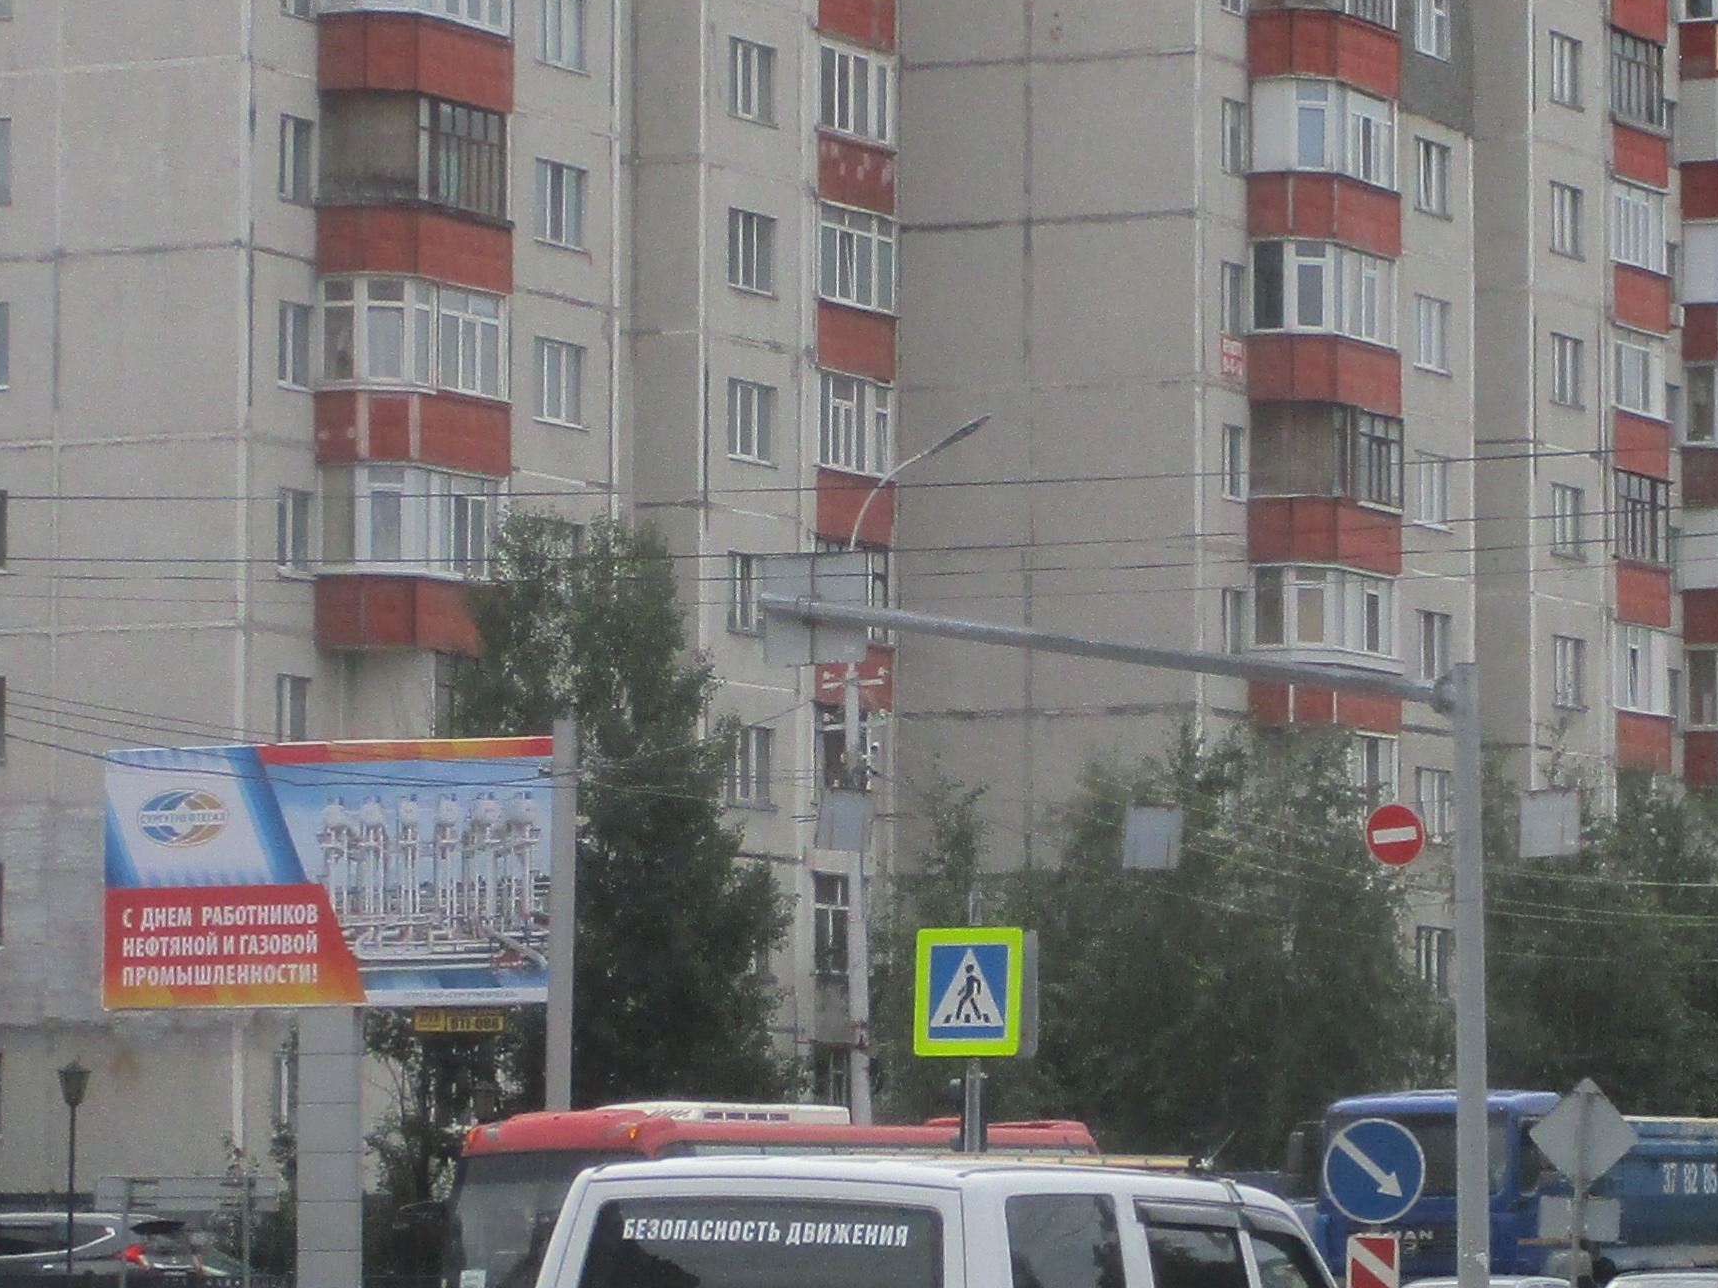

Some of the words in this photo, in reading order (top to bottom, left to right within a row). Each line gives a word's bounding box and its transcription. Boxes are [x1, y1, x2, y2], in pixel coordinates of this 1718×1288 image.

[122, 908, 133, 928] С
[140, 906, 192, 932] ДНЕМ
[201, 904, 318, 927] РАБОТНИКОВ
[122, 931, 218, 958] НЕФТЯНОЙ
[223, 935, 235, 956] И
[239, 929, 318, 955] ГАЗОВОЙ
[122, 963, 319, 987] ПРОМЫШЛЕННОСТИ!
[622, 1218, 781, 1243] БЕЗОПАСНОСТЬ
[785, 1221, 910, 1248] ДВИЖЕНИЯ
